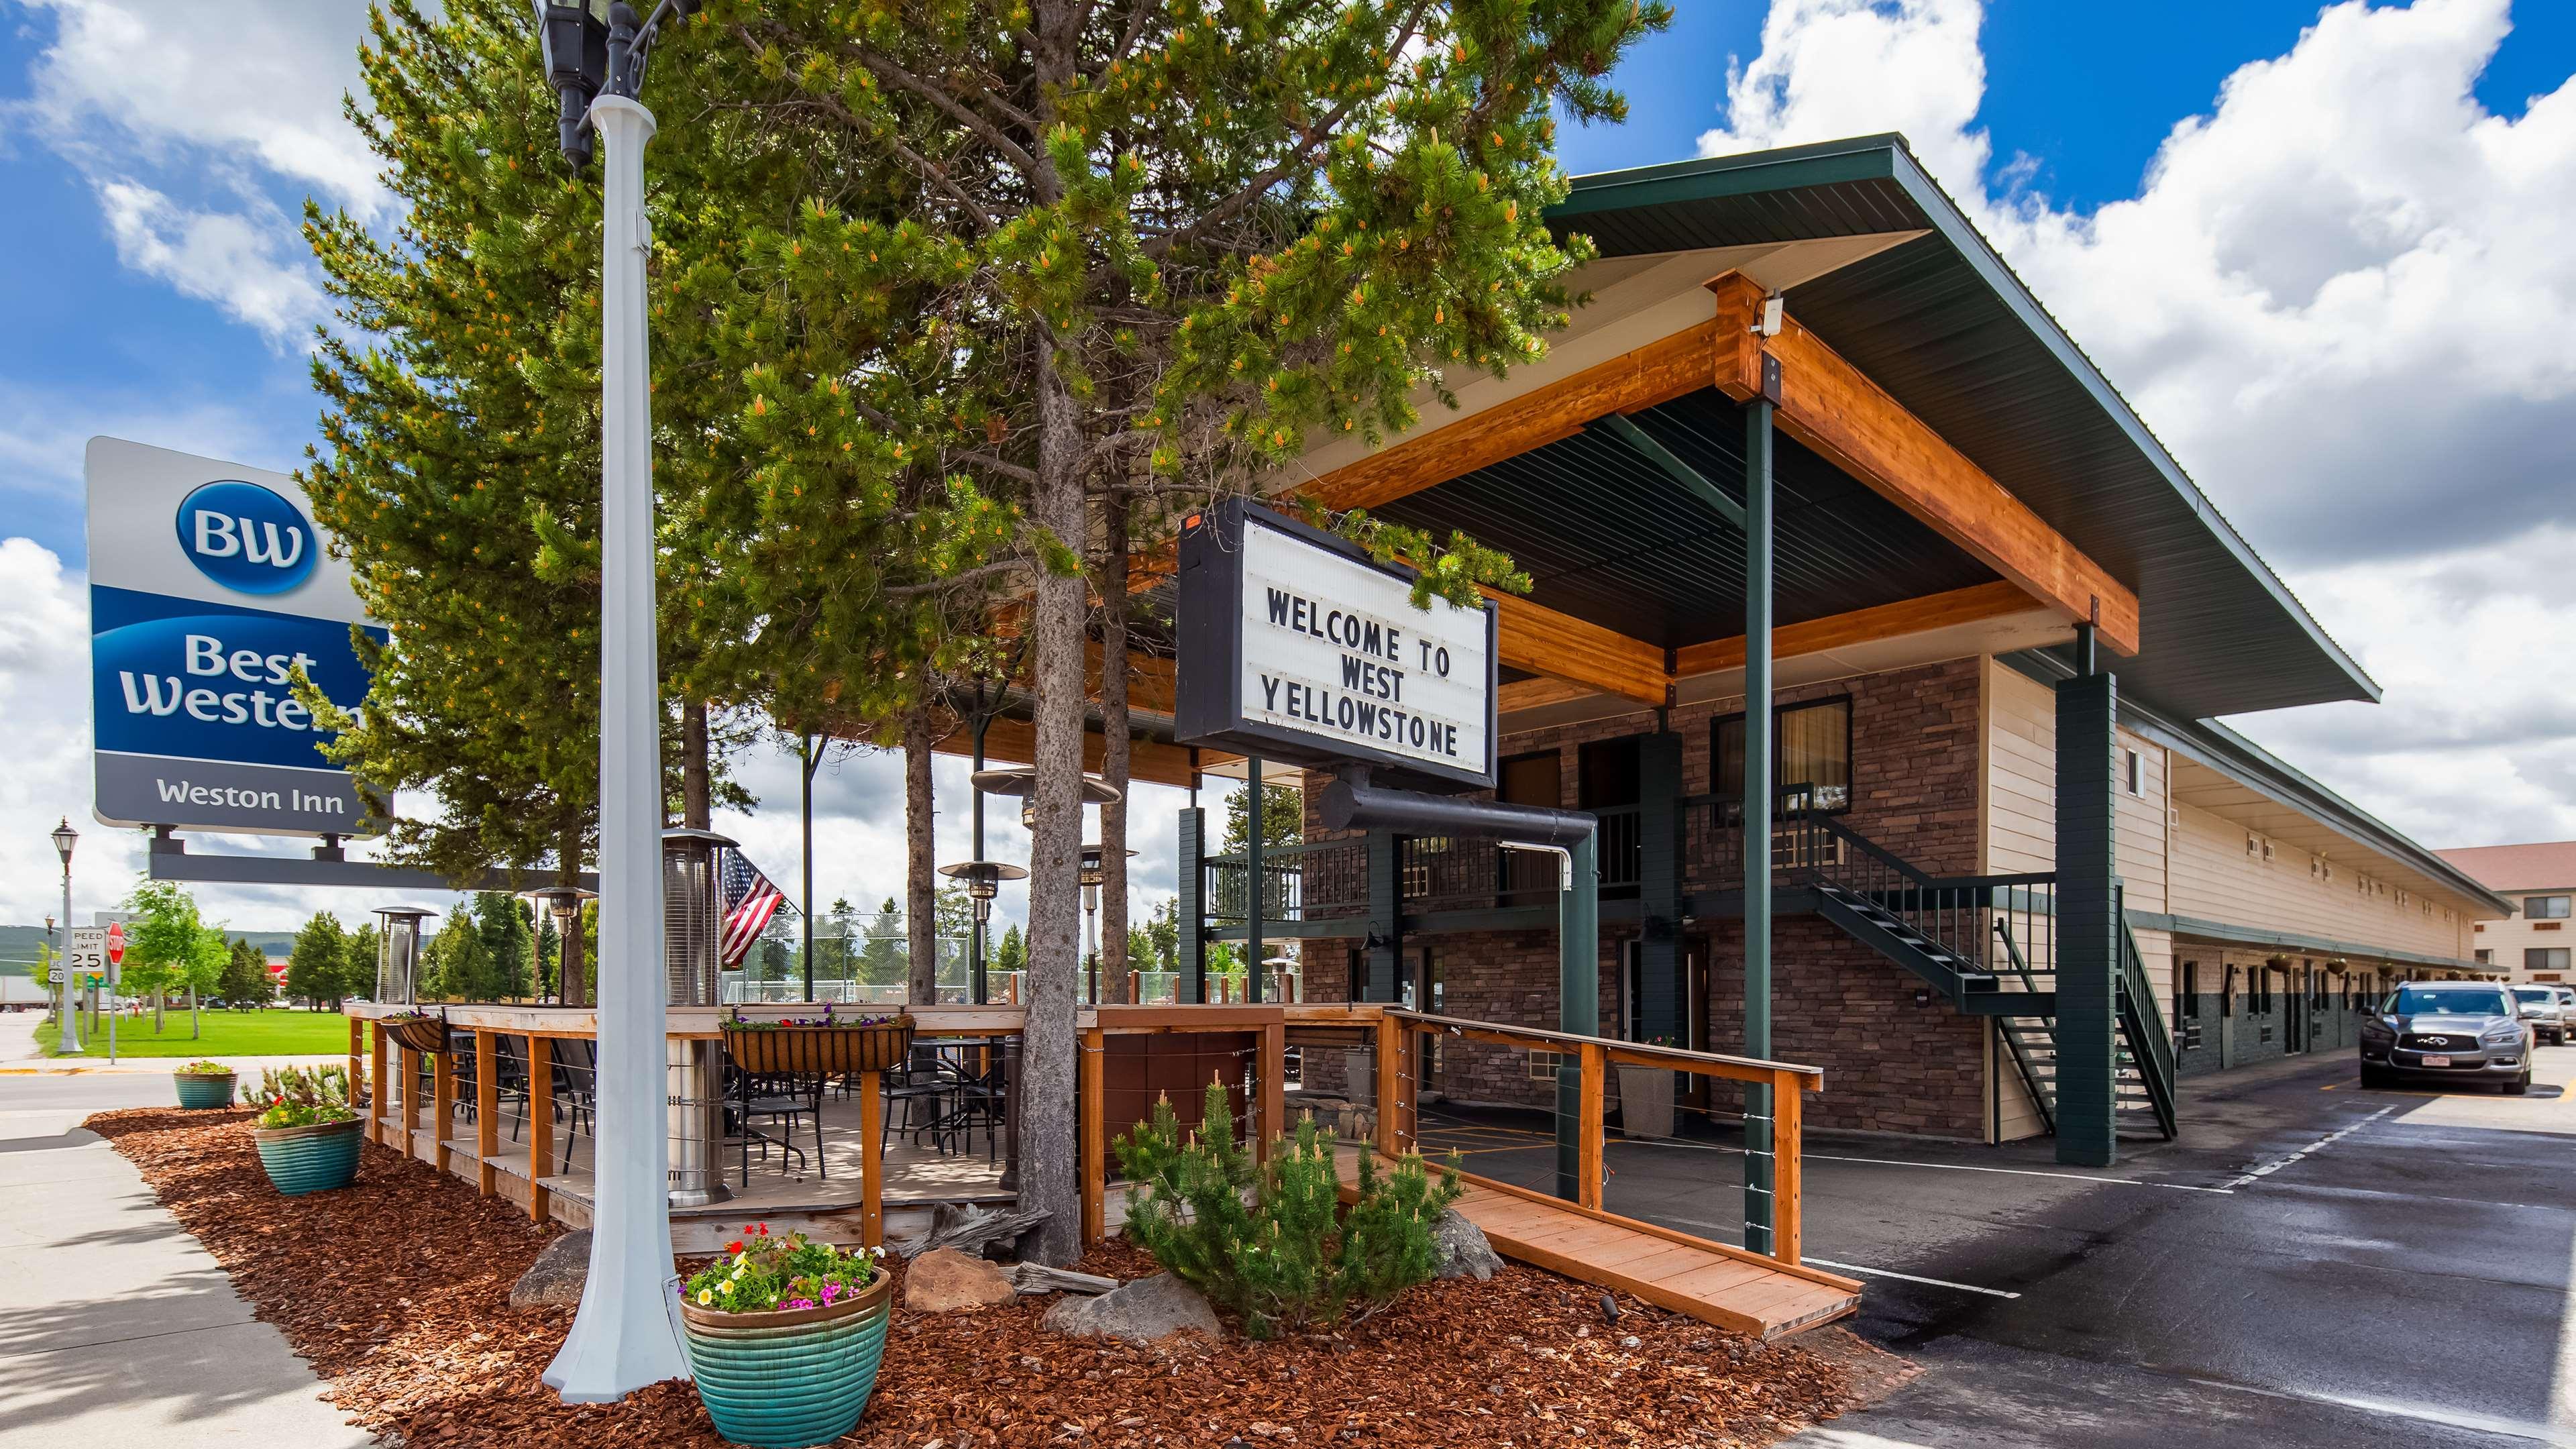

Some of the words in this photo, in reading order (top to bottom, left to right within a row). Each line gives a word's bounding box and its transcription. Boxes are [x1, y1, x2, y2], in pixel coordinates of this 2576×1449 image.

[195, 510, 304, 568] BW
[1267, 587, 1400, 662] WELCOME
[1419, 639, 1450, 678] TO
[185, 634, 317, 686] Best
[1341, 653, 1404, 703] WEST
[1260, 674, 1457, 757] YELLOWSTONE
[156, 778, 282, 810] Weston
[292, 789, 345, 814] Inn
[72, 953, 101, 967] 25
[109, 934, 123, 951] STOP
[52, 972, 64, 980] 20
